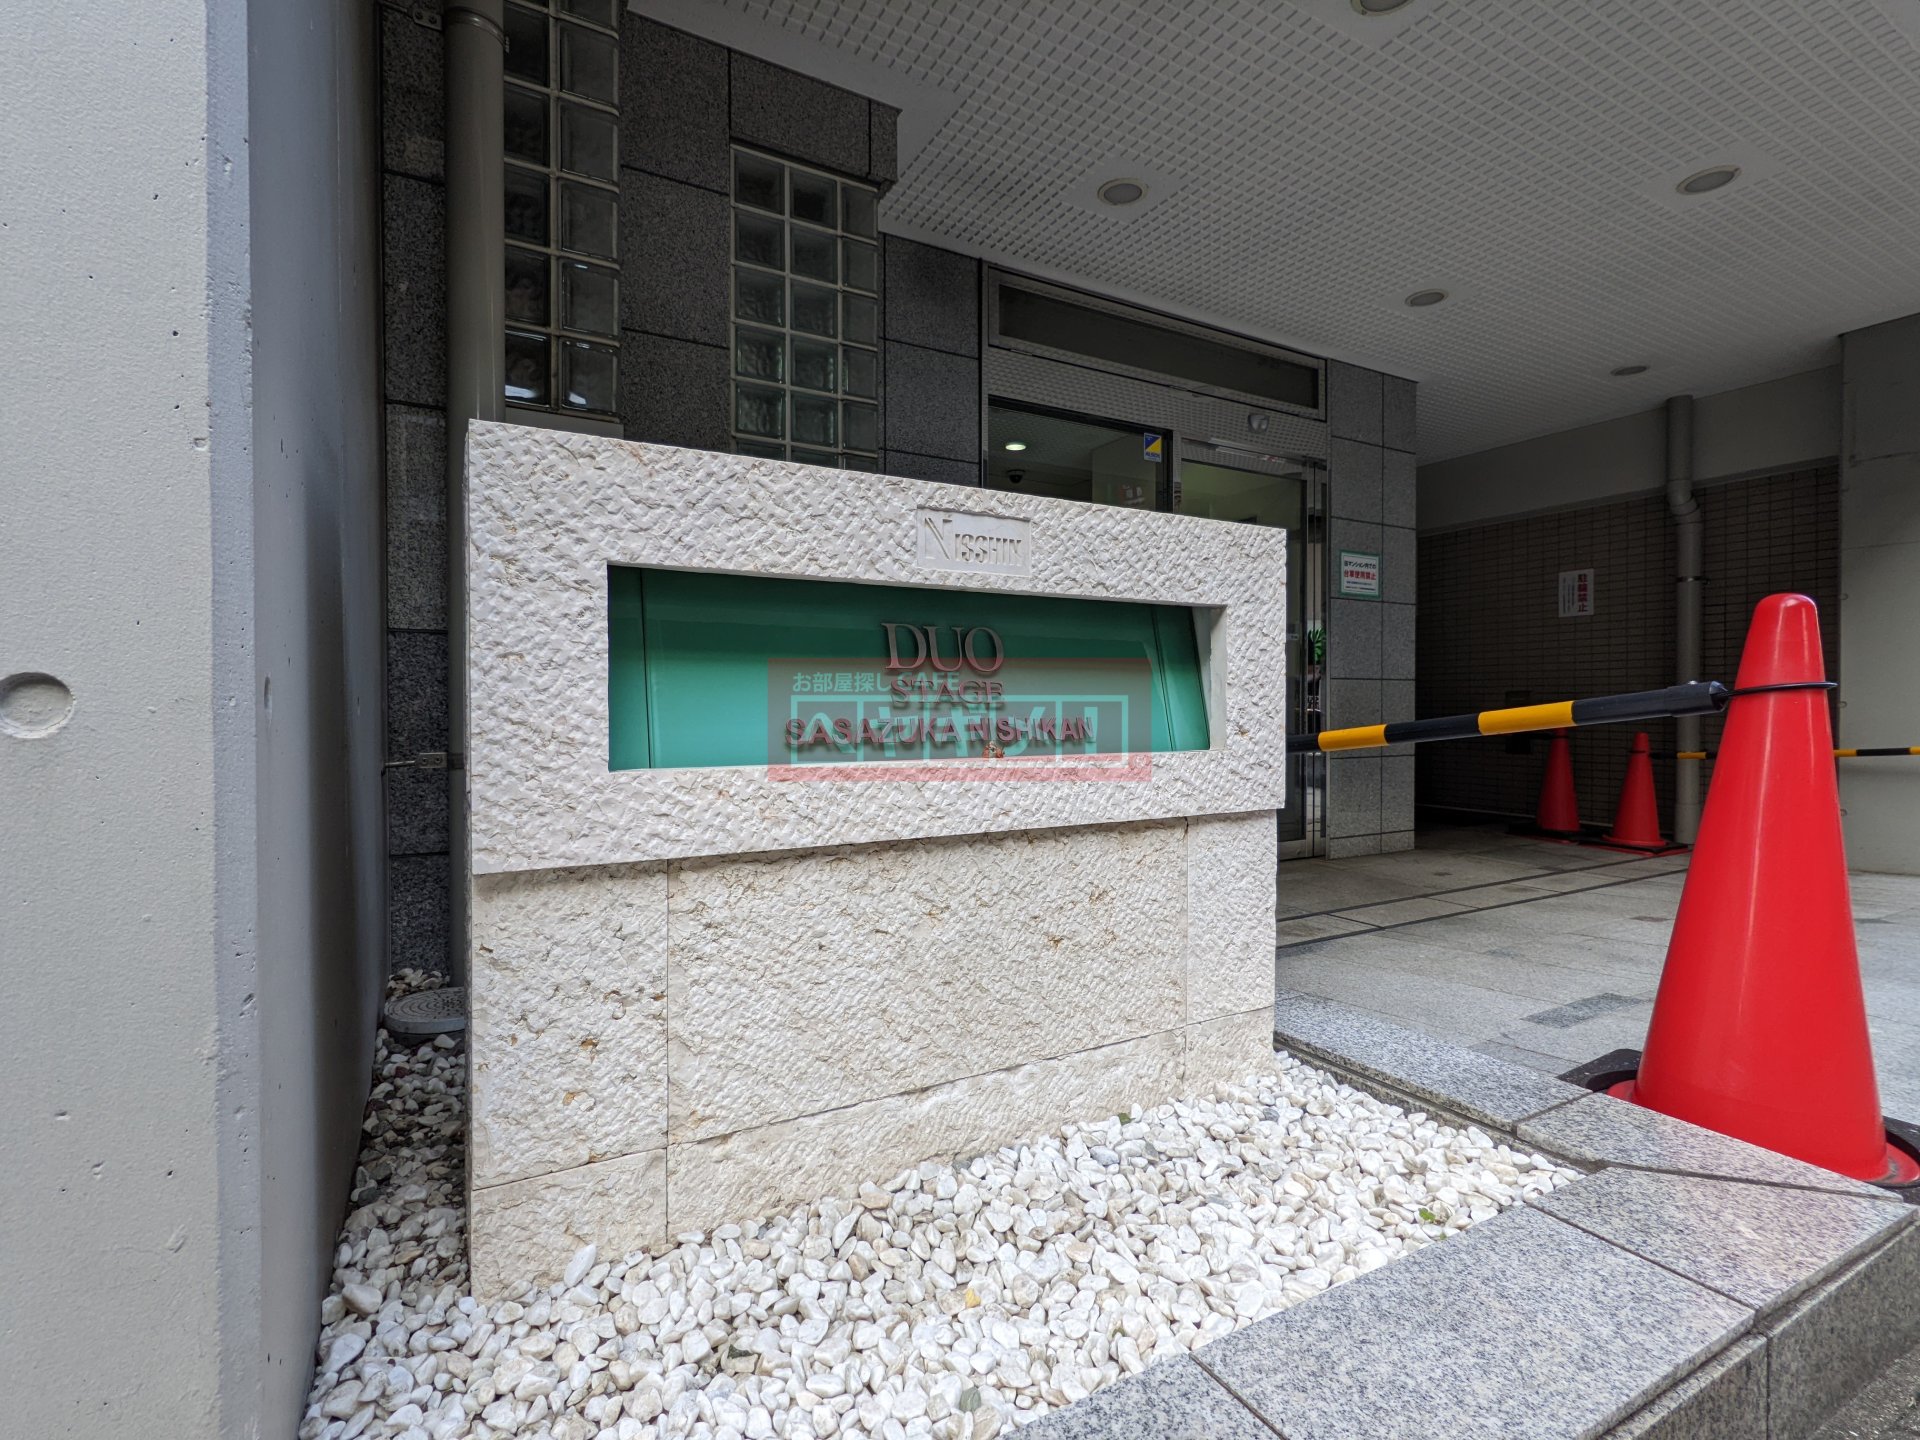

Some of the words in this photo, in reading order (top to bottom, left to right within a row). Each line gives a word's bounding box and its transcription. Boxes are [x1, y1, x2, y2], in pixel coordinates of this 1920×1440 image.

[881, 622, 1004, 673] DUO
[891, 679, 1004, 704] STAGE
[785, 717, 962, 745] SASAZUKA
[969, 716, 1095, 741] NISHIKAN
